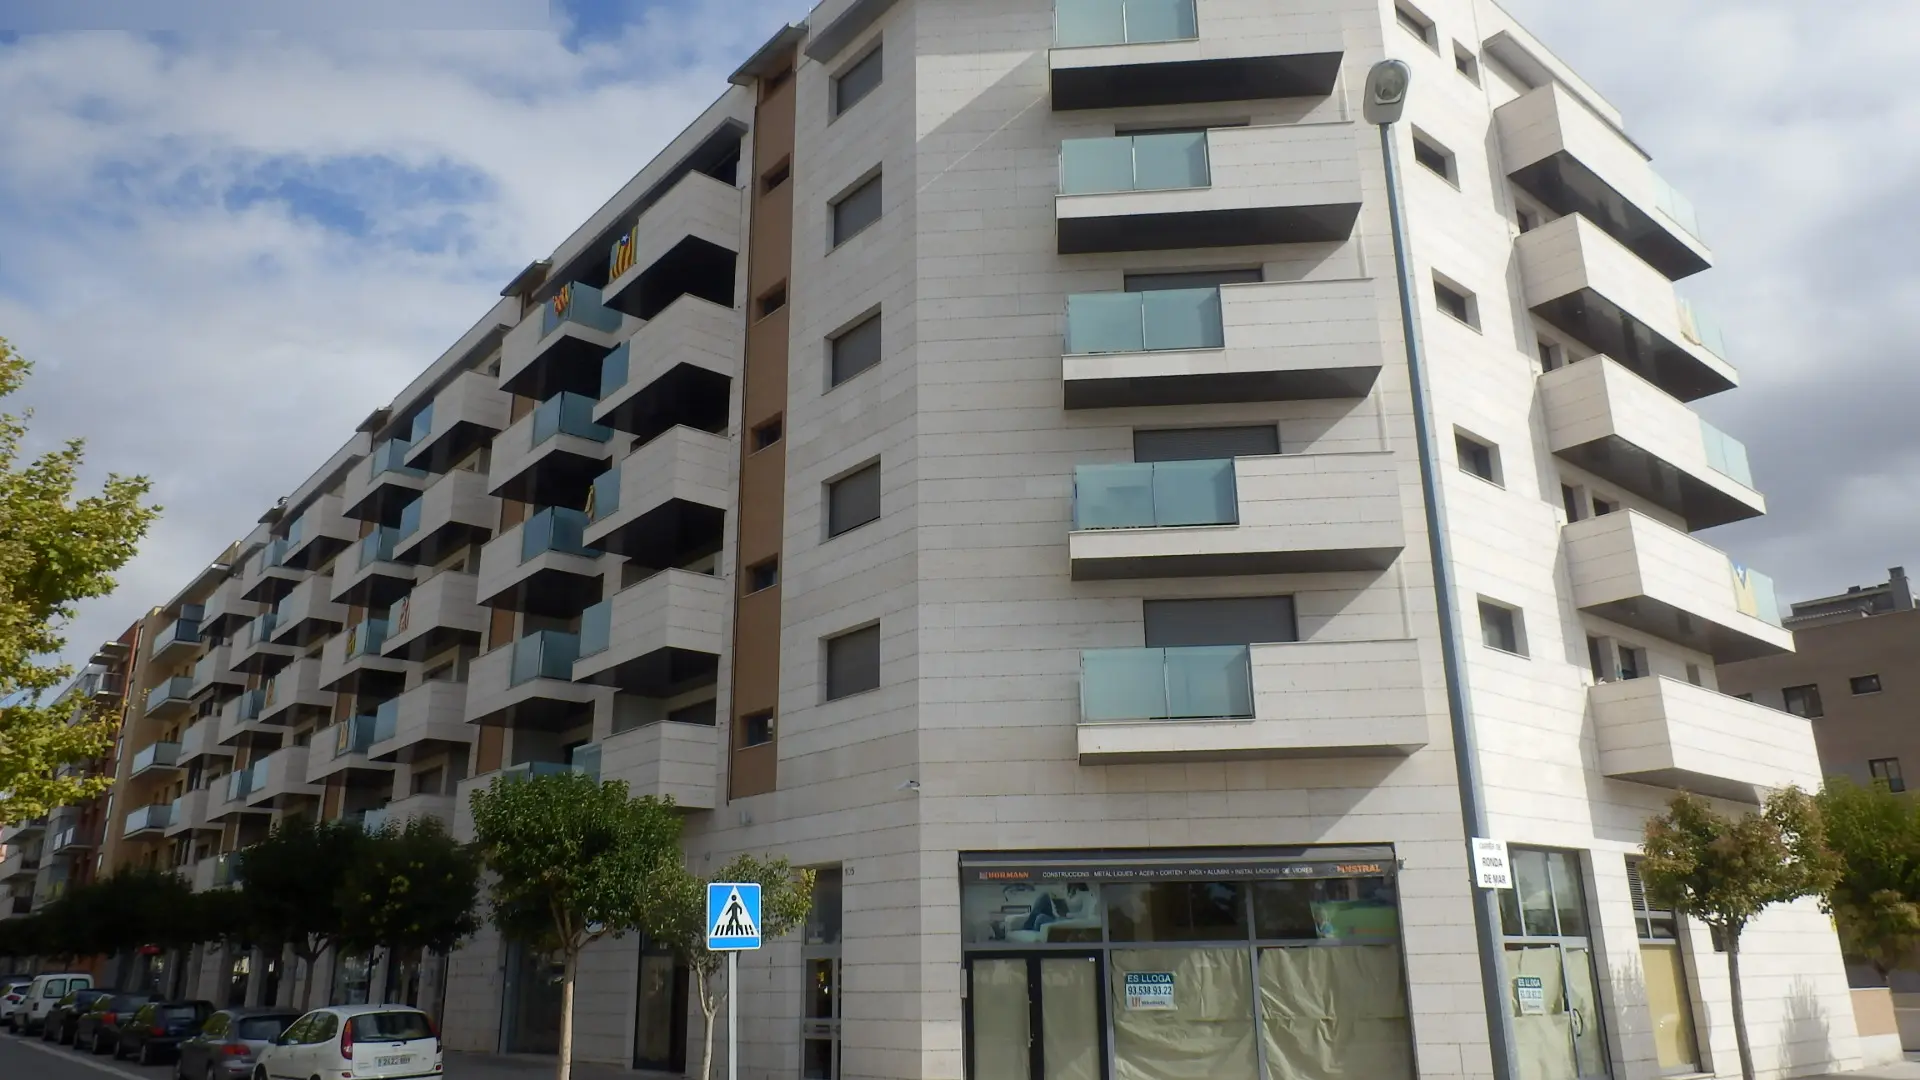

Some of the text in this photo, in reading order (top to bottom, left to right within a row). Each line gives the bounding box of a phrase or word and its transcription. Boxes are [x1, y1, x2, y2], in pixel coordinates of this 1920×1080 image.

[1482, 857, 1502, 867] RONDA
[1484, 874, 1506, 884] DE MAR
[1127, 974, 1171, 983] ES LLOGA
